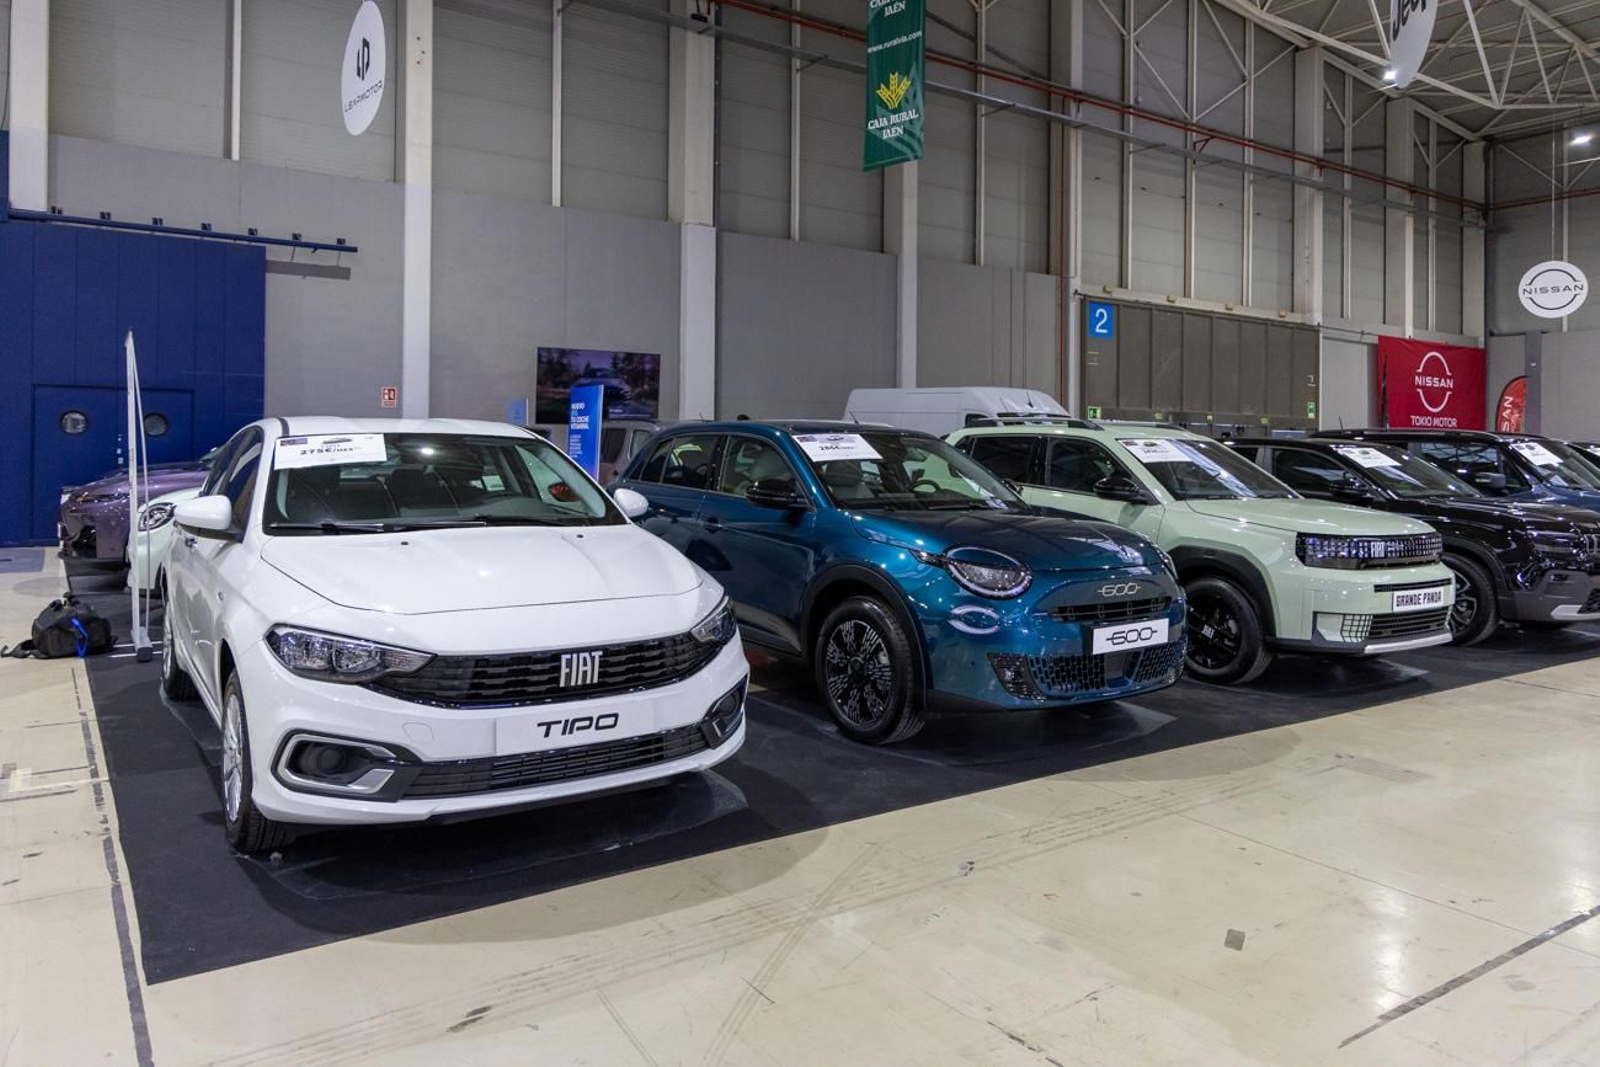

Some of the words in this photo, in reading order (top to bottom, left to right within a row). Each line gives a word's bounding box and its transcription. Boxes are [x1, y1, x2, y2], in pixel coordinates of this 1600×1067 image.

[867, 31, 922, 55] www.ruralvia.com
[344, 80, 383, 113] LEAPMOTOR
[868, 117, 888, 129] CAJA
[890, 109, 919, 124] RURAL
[1522, 284, 1584, 295] NISSAN
[1095, 308, 1108, 333] 2
[1415, 375, 1453, 388] NISSAN
[1410, 415, 1431, 427] TOKIO
[1433, 417, 1457, 428] MOTOR
[1371, 541, 1385, 558] FIAT
[1396, 593, 1421, 607] GRANDE
[1423, 590, 1441, 604] PANDA
[559, 651, 603, 687] FIAT
[537, 712, 619, 738] TIPO
